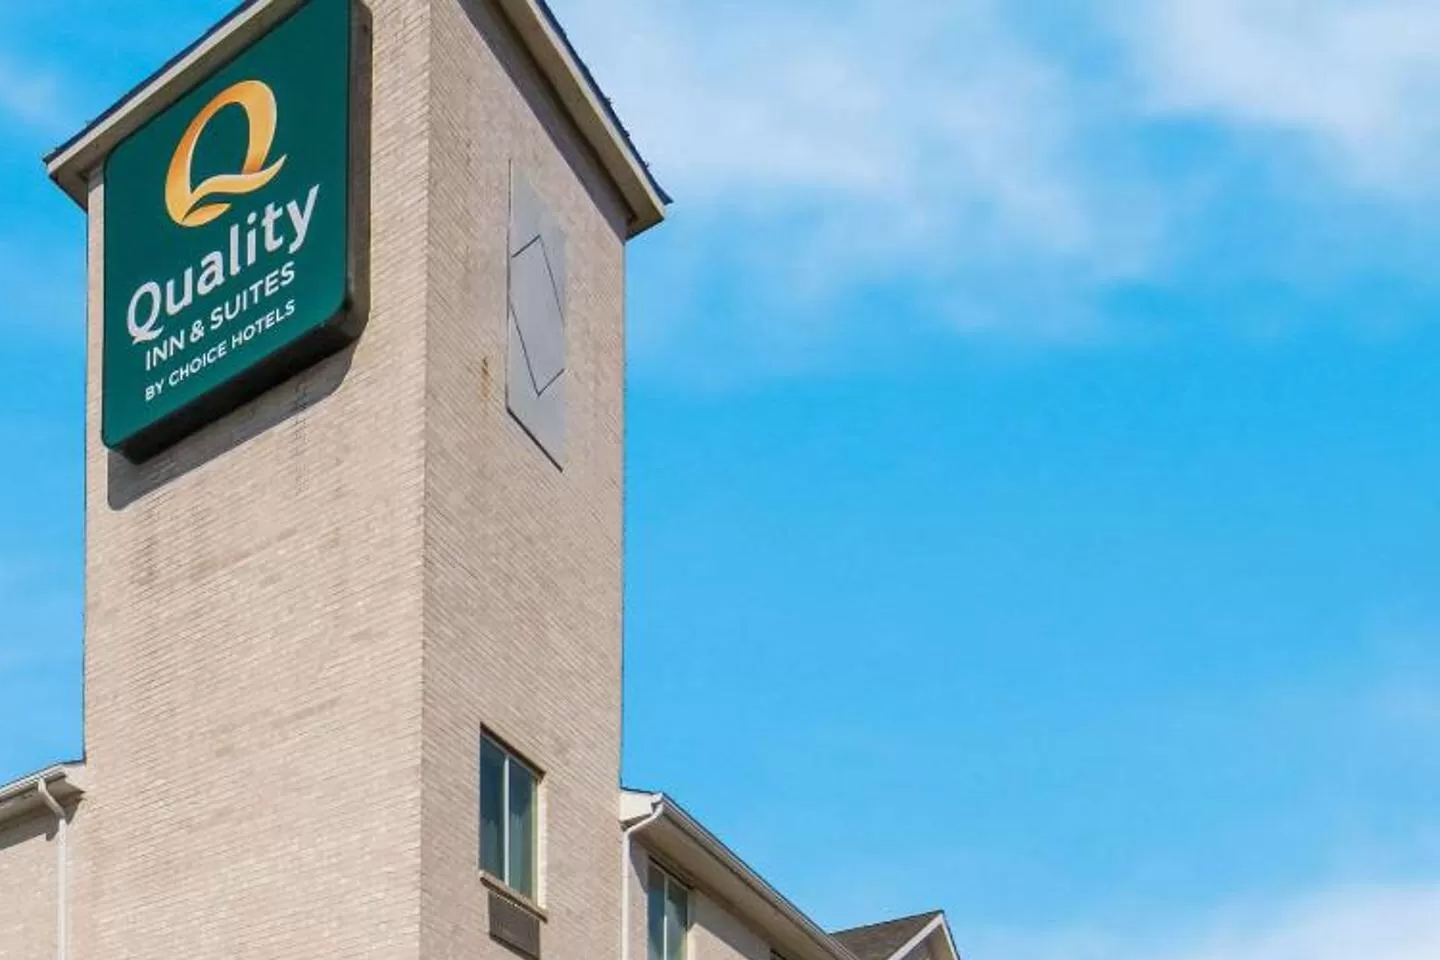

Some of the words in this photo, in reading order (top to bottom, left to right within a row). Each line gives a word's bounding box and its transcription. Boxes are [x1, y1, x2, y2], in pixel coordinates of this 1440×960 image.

[165, 80, 287, 227] Q
[127, 184, 319, 345] Quality
[145, 330, 185, 371] INN
[190, 319, 205, 343] &
[210, 261, 295, 331] SUITES
[145, 379, 164, 402] BY
[168, 341, 227, 387] CHOICE
[231, 299, 295, 350] HOTELS
